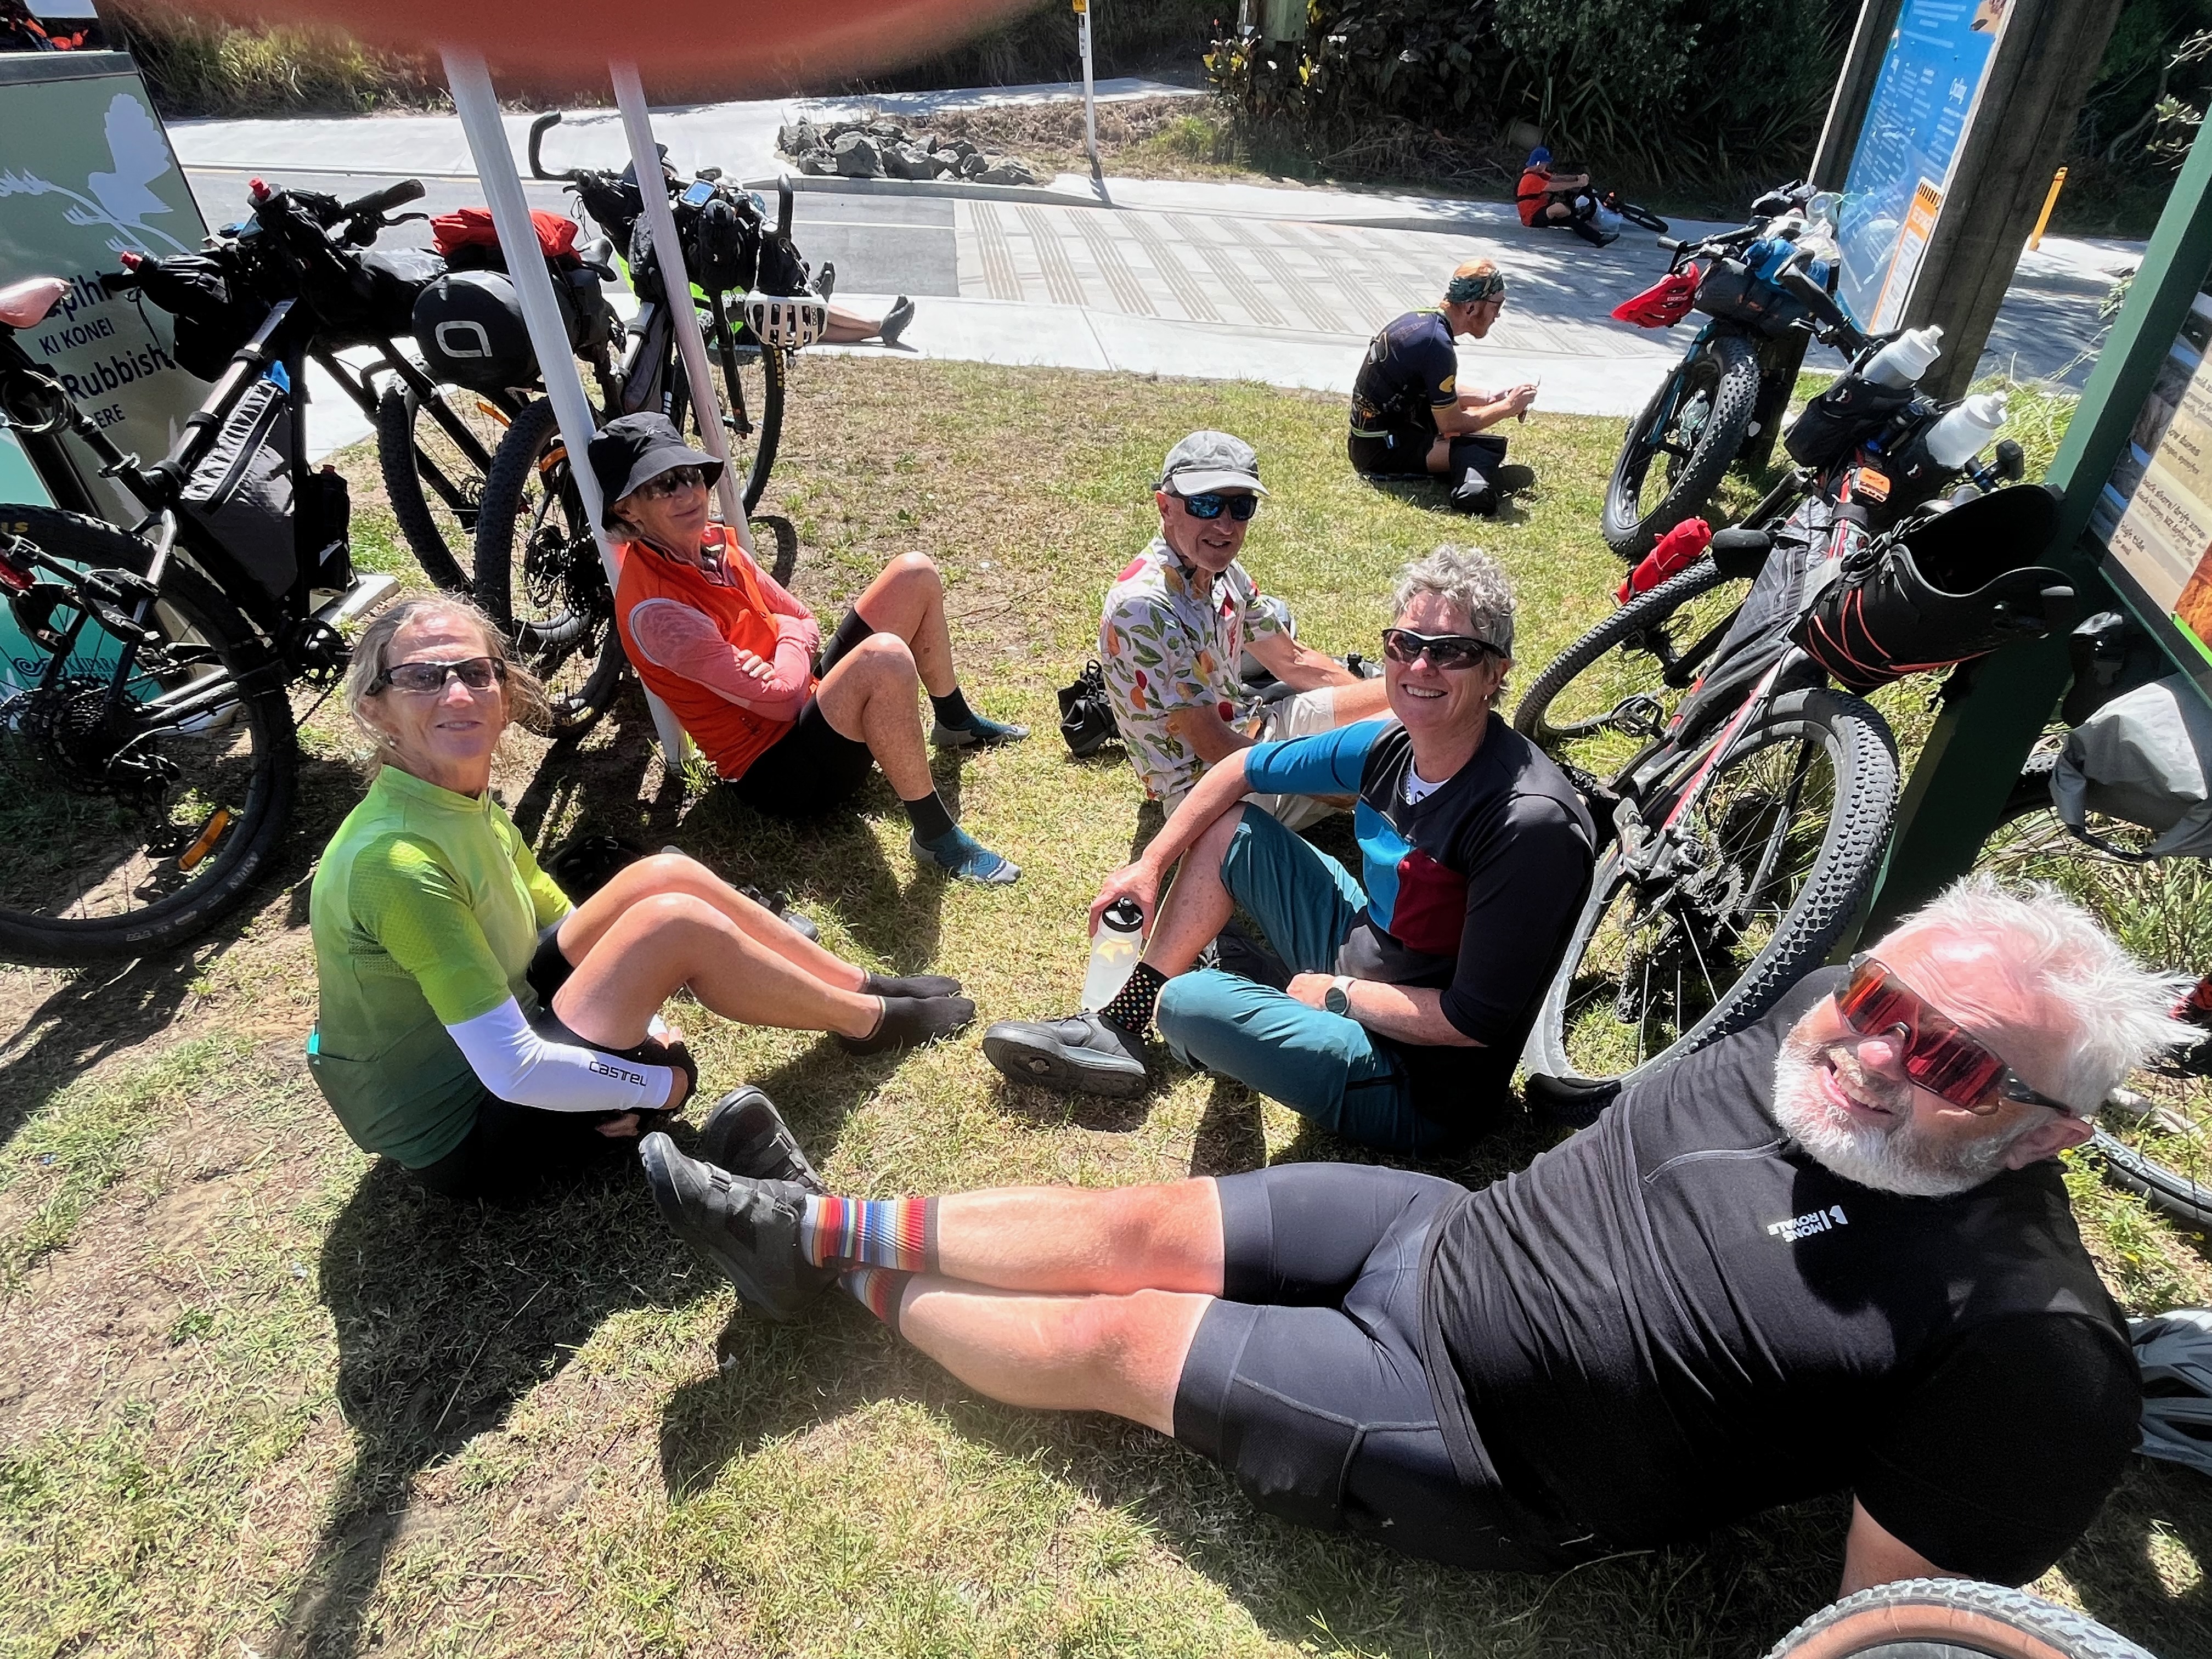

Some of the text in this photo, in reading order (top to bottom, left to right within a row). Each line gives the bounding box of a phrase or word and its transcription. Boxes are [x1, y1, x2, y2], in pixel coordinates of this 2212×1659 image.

[38, 317, 116, 356] KI KONEI
[60, 343, 173, 403] Rubbish
[93, 404, 126, 428] ERE
[1767, 1212, 1820, 1235] ROYALE
[1782, 1222, 1825, 1243] MONS
